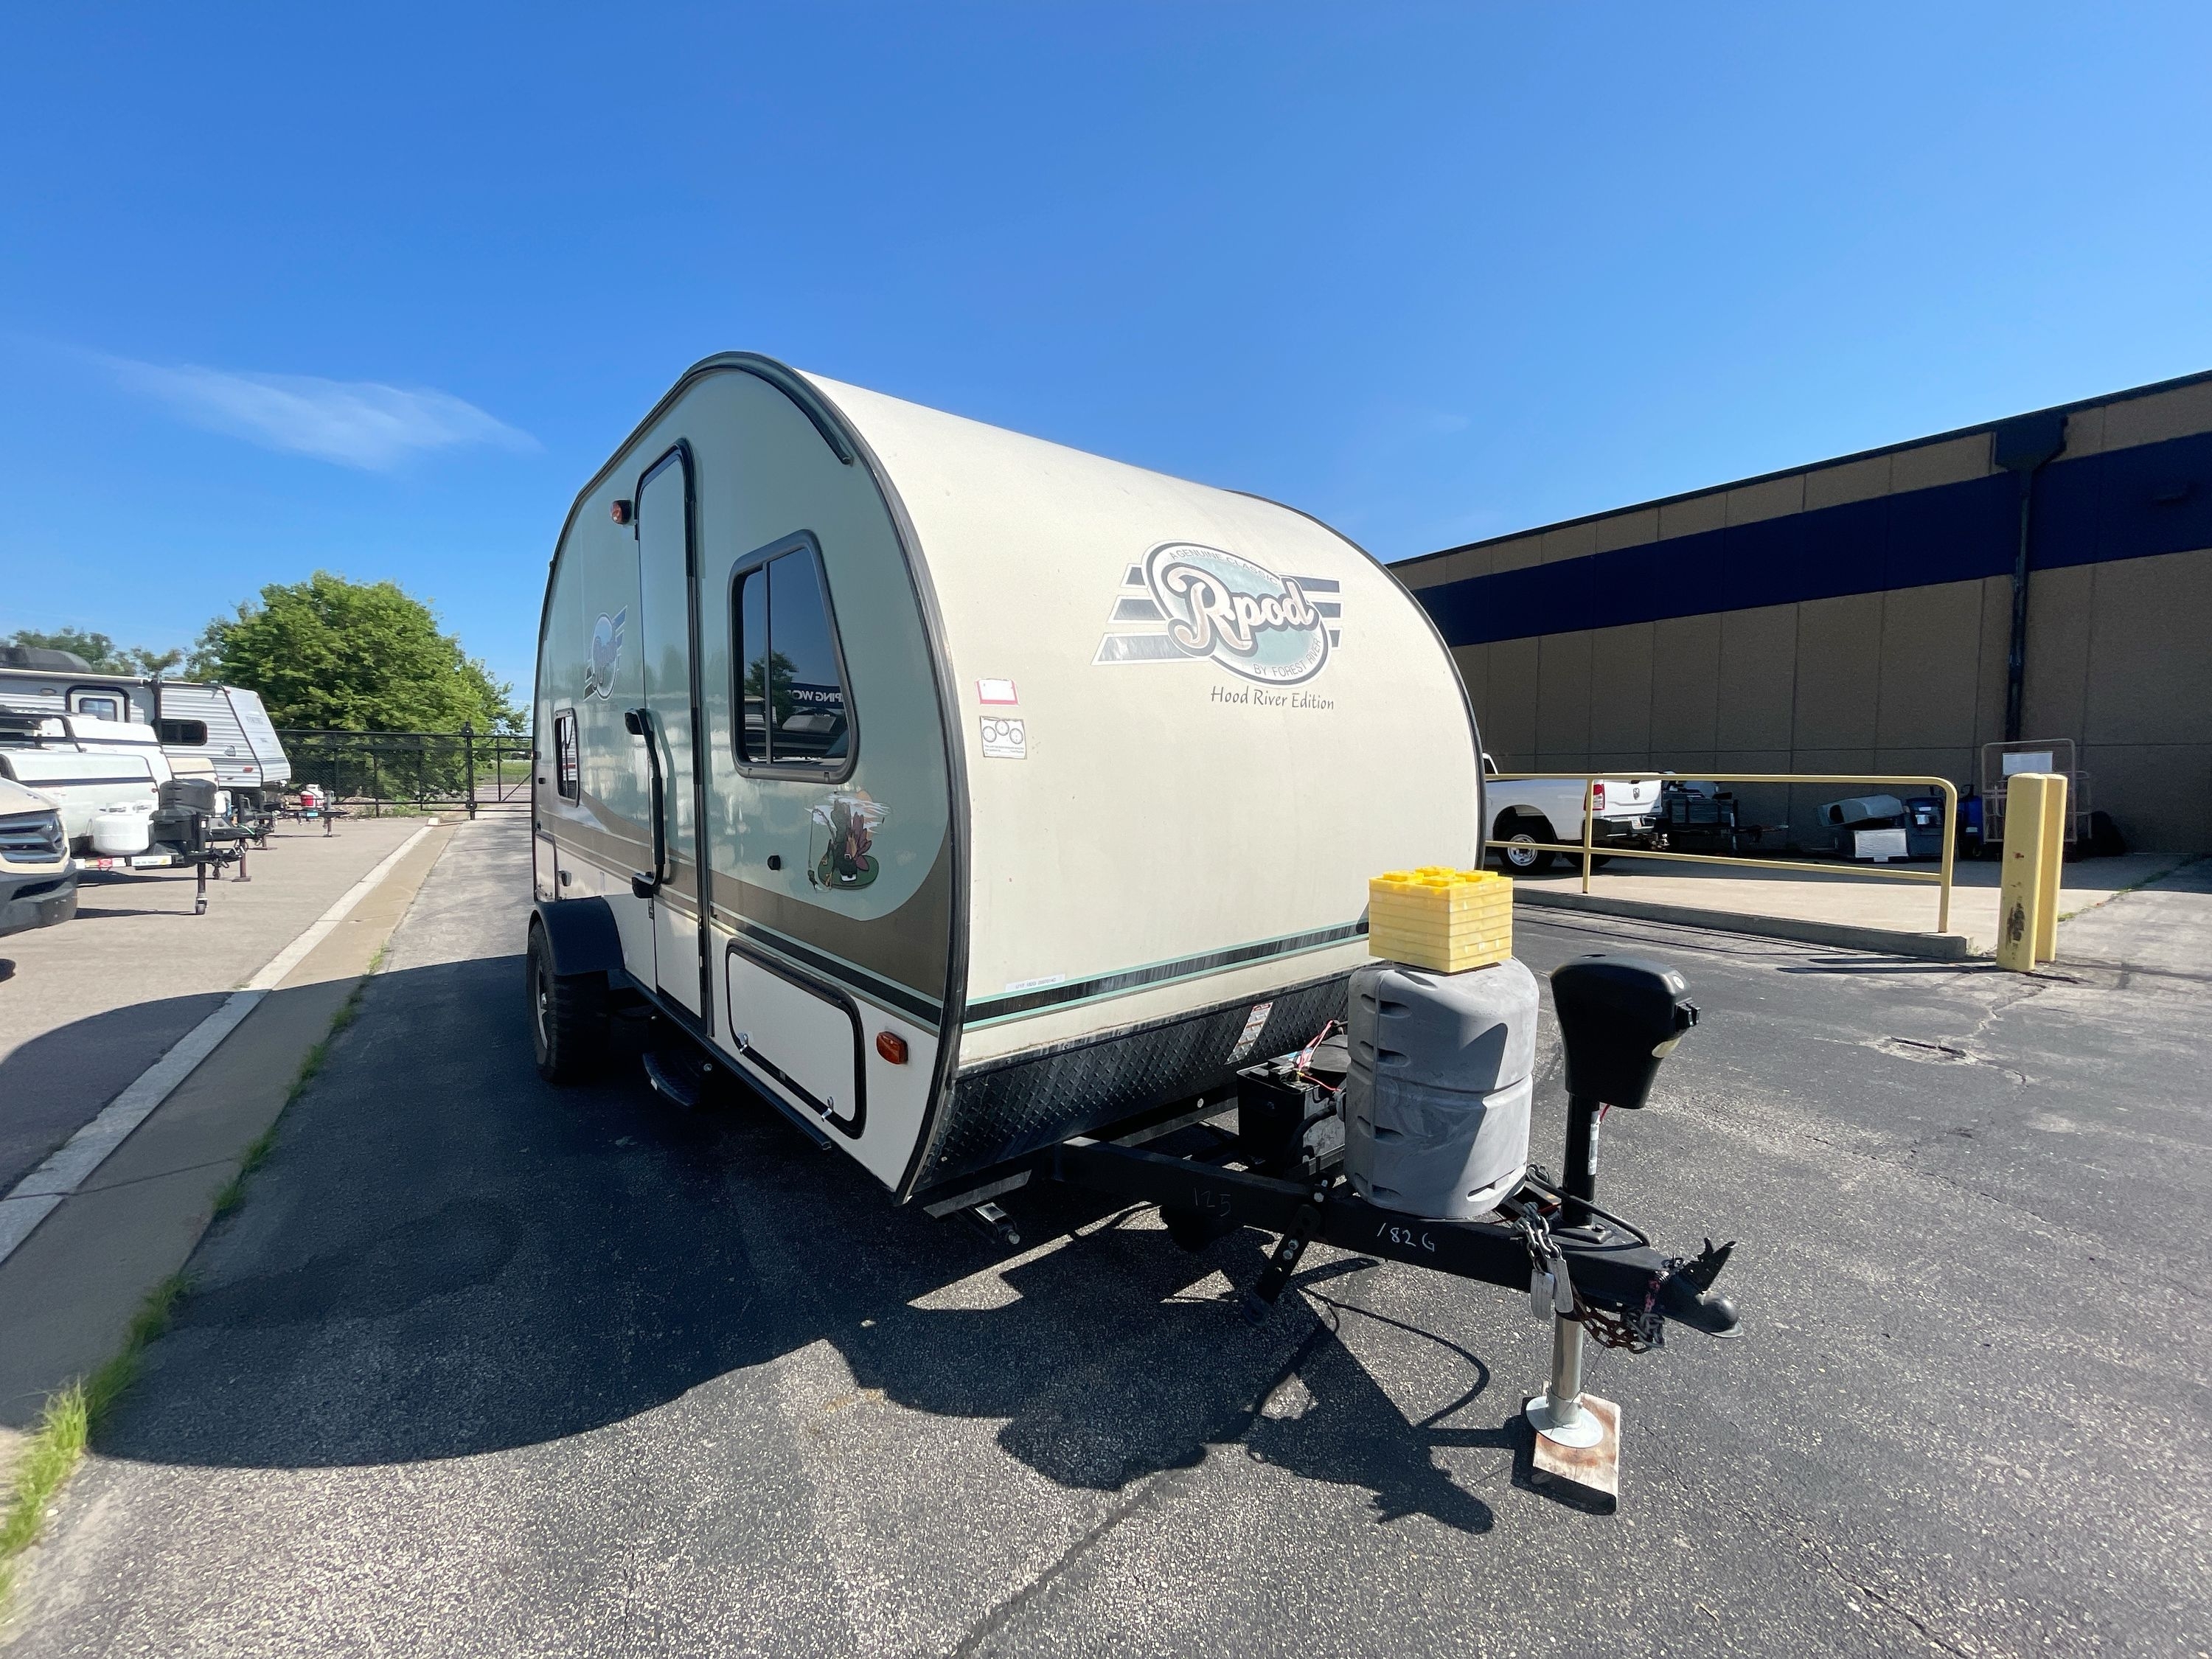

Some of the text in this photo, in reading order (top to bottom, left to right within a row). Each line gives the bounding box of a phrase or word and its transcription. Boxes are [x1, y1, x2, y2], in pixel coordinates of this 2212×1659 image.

[1169, 549, 1278, 585] A GENUINE CLASSIC
[1165, 565, 1317, 653] Rpod
[1253, 637, 1321, 678] BY FOREST RIVER
[1211, 685, 1335, 710] Hood River Edition
